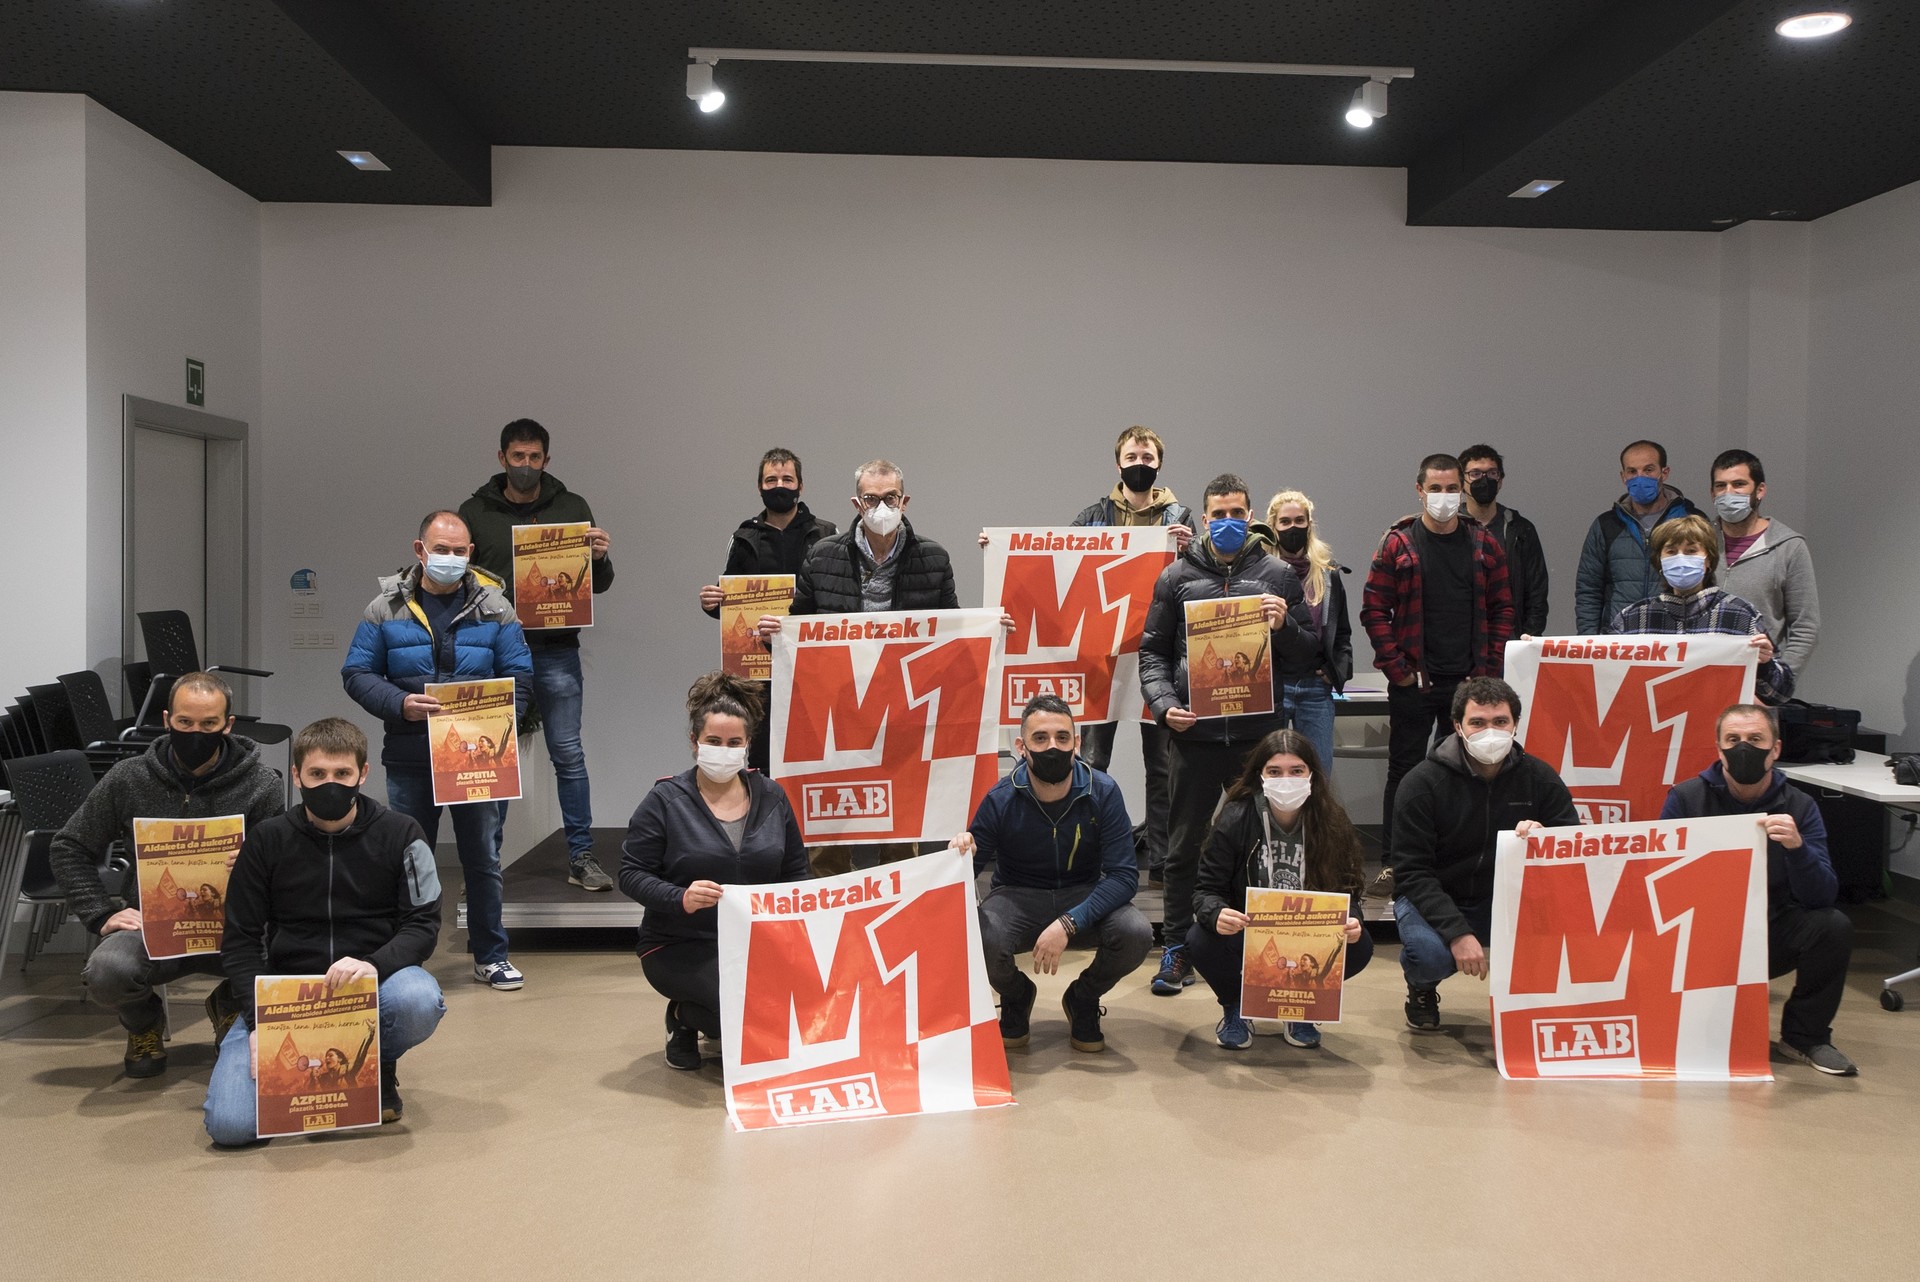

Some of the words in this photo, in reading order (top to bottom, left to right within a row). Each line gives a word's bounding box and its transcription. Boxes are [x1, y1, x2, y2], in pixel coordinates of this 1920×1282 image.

[541, 529, 564, 540] M1
[1009, 532, 1115, 550] Maiatzak
[1121, 532, 1130, 548] 1
[746, 580, 769, 591] M1
[1000, 552, 1175, 656] M1
[1215, 603, 1240, 617] M1
[799, 618, 920, 642] Maiatzak
[928, 617, 938, 636] 1
[1541, 639, 1670, 661] Maiatzak
[1676, 642, 1688, 662] 1
[457, 686, 484, 699] M1
[1013, 679, 1080, 703] LAB
[1212, 686, 1250, 695] AZPEITIA
[479, 695, 504, 704] aukera
[783, 637, 992, 763] M1
[1524, 662, 1746, 786] M1
[457, 770, 496, 780] AZPEITIA
[469, 788, 489, 796] LAB
[809, 787, 887, 817] LAB
[1574, 805, 1622, 824] AB
[173, 825, 205, 841] M1
[144, 844, 186, 852] Aldaketa
[201, 837, 233, 847] aukera
[1526, 828, 1668, 860] Maiatzak
[1676, 827, 1687, 850] 1
[751, 877, 882, 915] Maiatzak
[890, 870, 901, 895] 1
[1282, 896, 1313, 912] M1
[174, 921, 223, 930] AZPEITIA
[1509, 848, 1753, 994] M1
[189, 939, 214, 948] LAB
[741, 881, 971, 1065] M1
[298, 983, 333, 1001] M1
[1269, 989, 1314, 999] AZPEITIA
[265, 1004, 311, 1015] Aldaketa
[314, 1001, 327, 1009] da
[328, 996, 363, 1007] aukera
[291, 1010, 322, 1019] Norabidea
[324, 1006, 351, 1014] aldatzera
[1280, 1007, 1303, 1015] LAB
[1540, 1022, 1631, 1059] LAB
[290, 1092, 347, 1106] AZPEITIA
[776, 1082, 875, 1117] LAB
[305, 1114, 334, 1126] LAB
